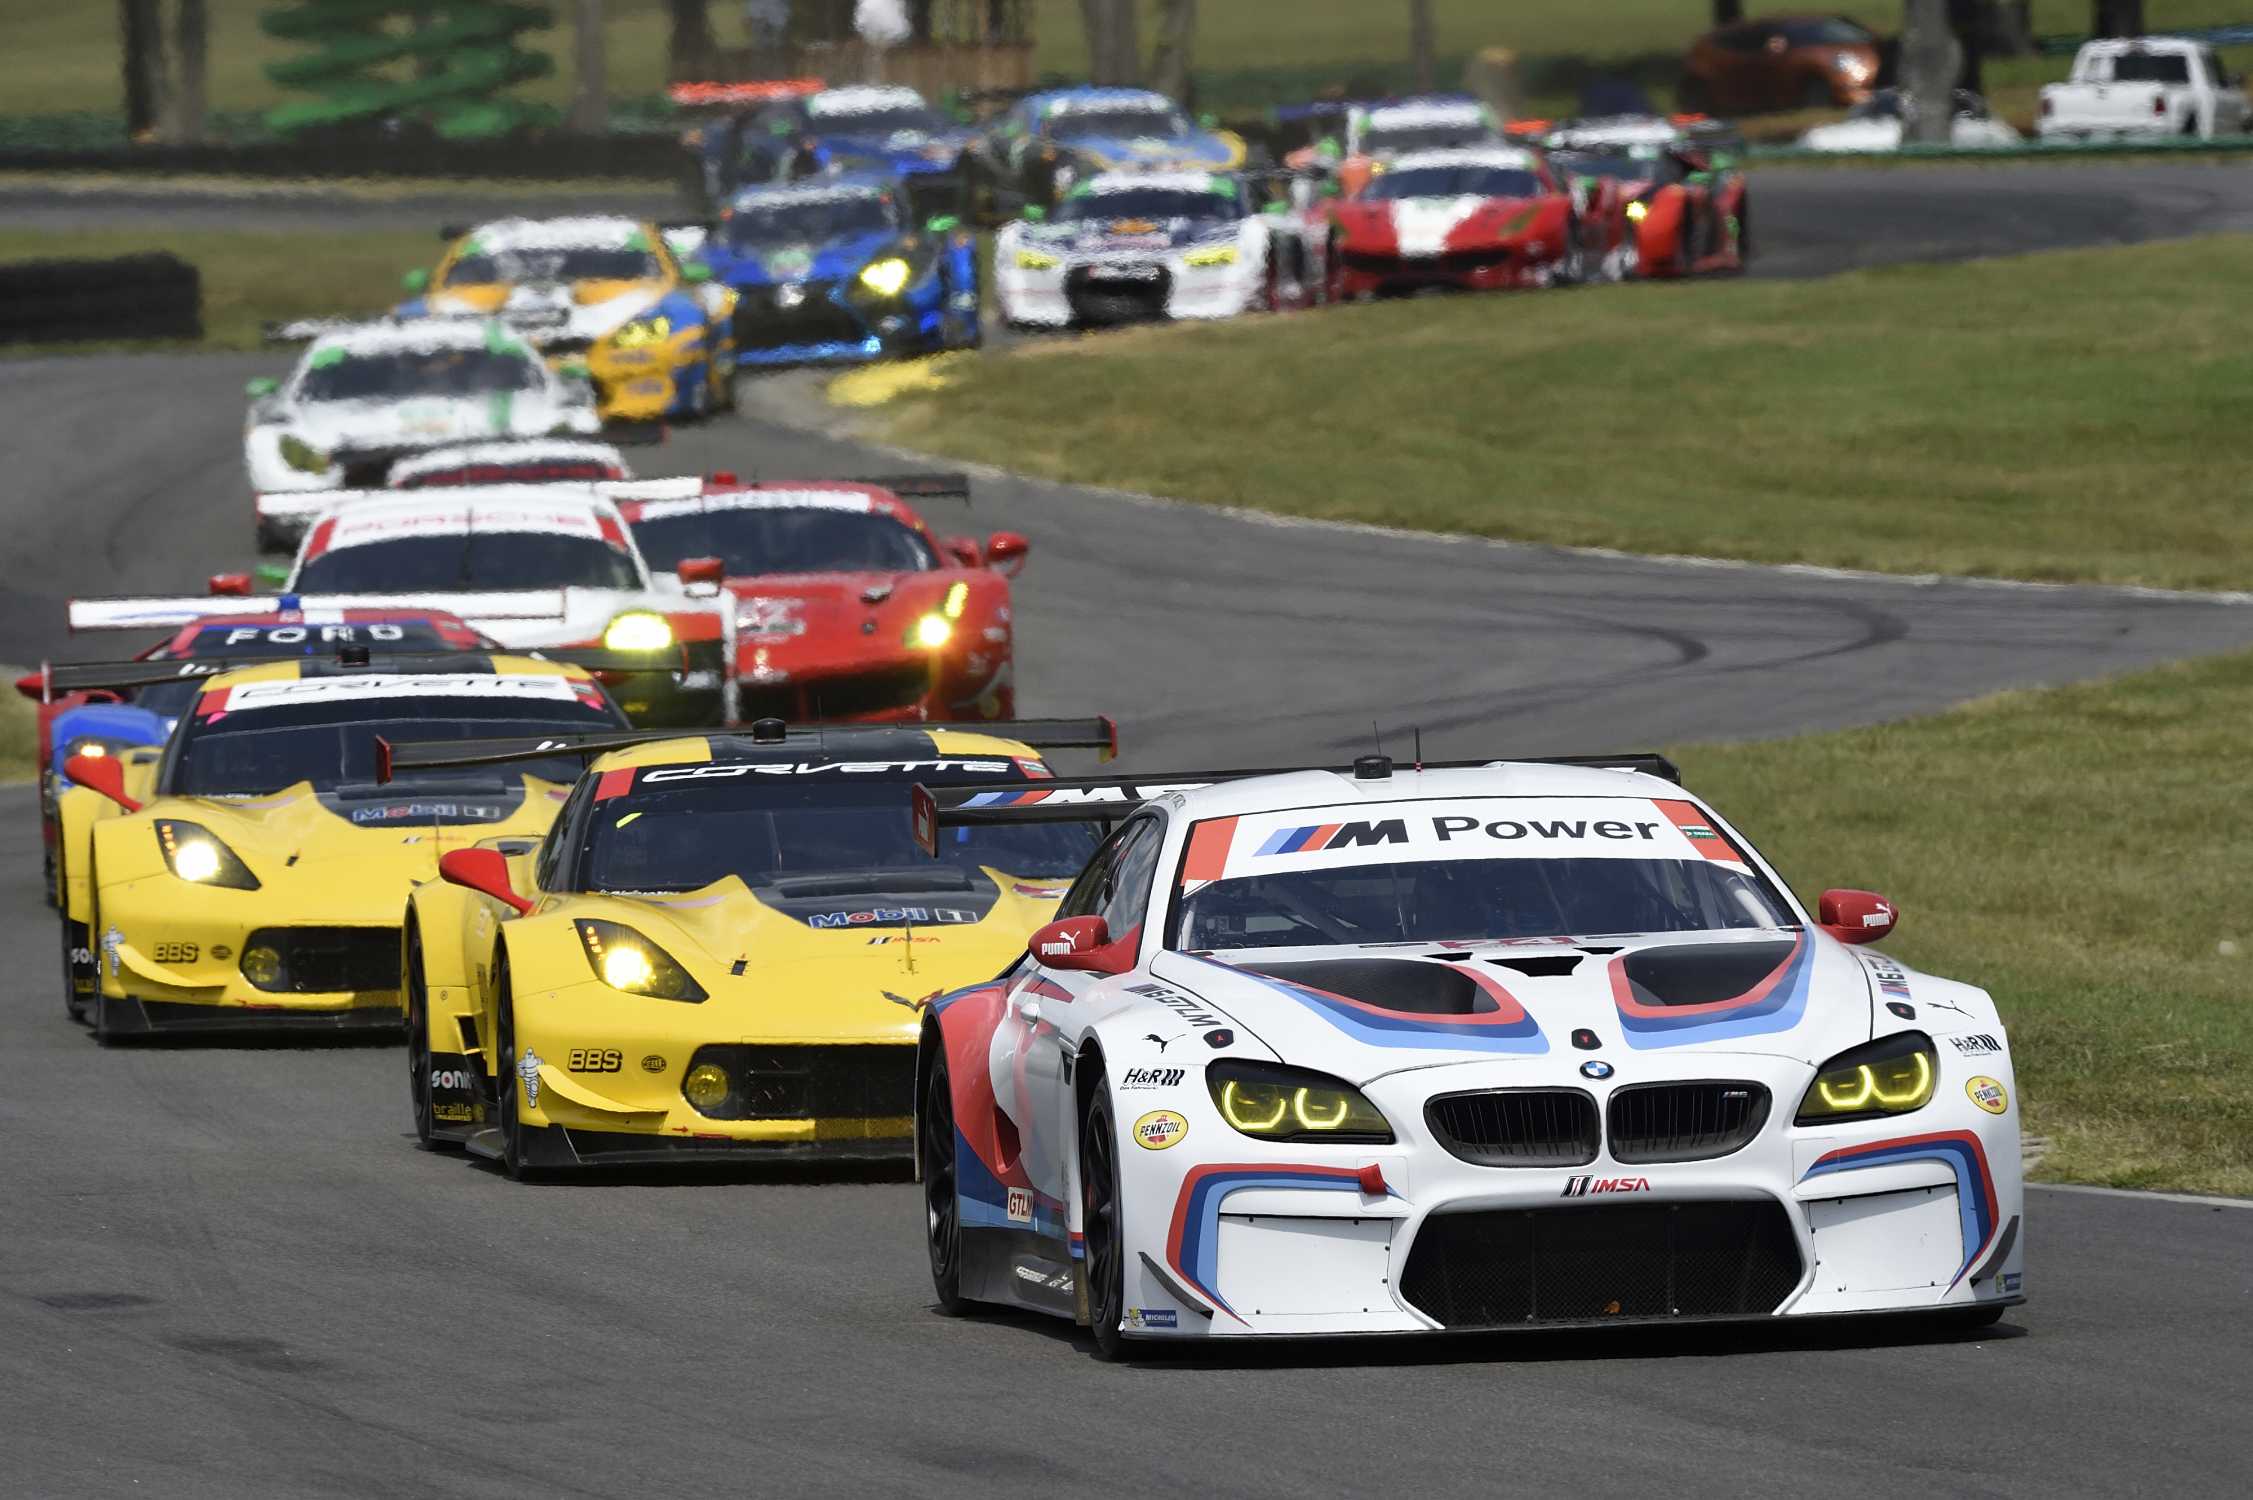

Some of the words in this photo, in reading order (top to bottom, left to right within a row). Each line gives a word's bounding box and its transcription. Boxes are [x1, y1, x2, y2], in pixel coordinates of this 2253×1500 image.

[226, 624, 404, 646] FORD
[240, 678, 562, 699] CORVETTE
[641, 759, 1010, 784] CORVETTE
[1432, 815, 1660, 841] Power
[808, 906, 929, 929] Mobil
[153, 941, 200, 963] BBS
[1041, 941, 1071, 956] PUMA
[567, 1048, 624, 1073] BBS
[1122, 1067, 1164, 1084] H&R
[1139, 1121, 1181, 1137] PENNZOIL
[1590, 1177, 1650, 1194] IMSA
